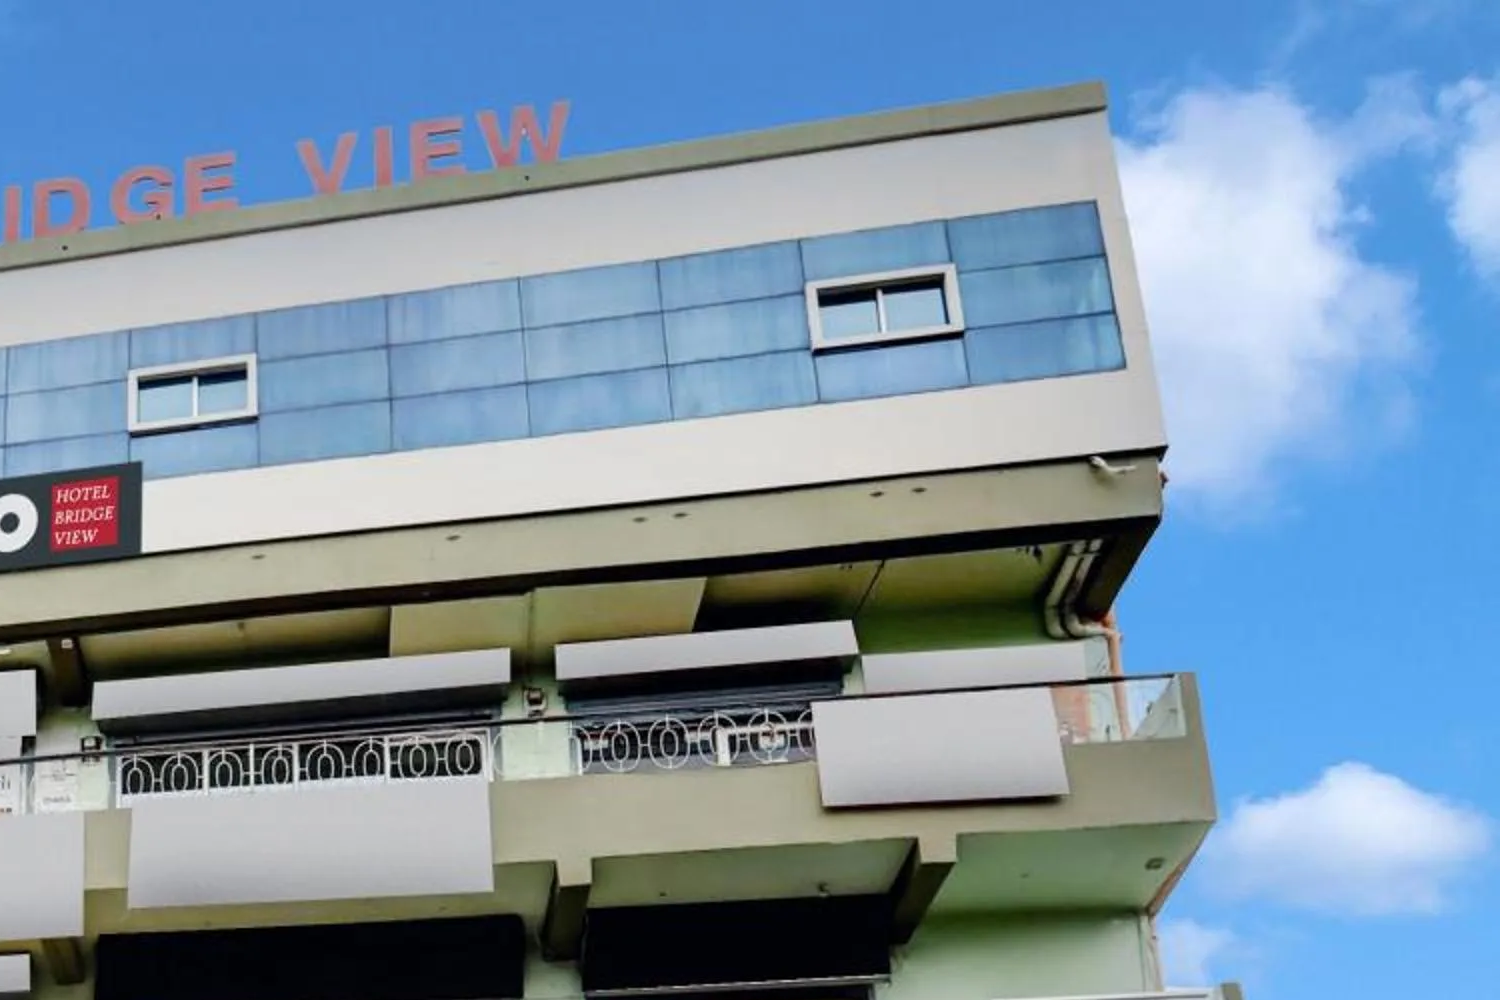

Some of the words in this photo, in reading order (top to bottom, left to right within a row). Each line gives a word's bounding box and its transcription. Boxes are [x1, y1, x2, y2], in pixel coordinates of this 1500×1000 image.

[297, 100, 570, 195] VIEW
[56, 485, 111, 503] HOTEL
[55, 505, 116, 524] BRIDGE
[54, 528, 99, 545] VIEW
